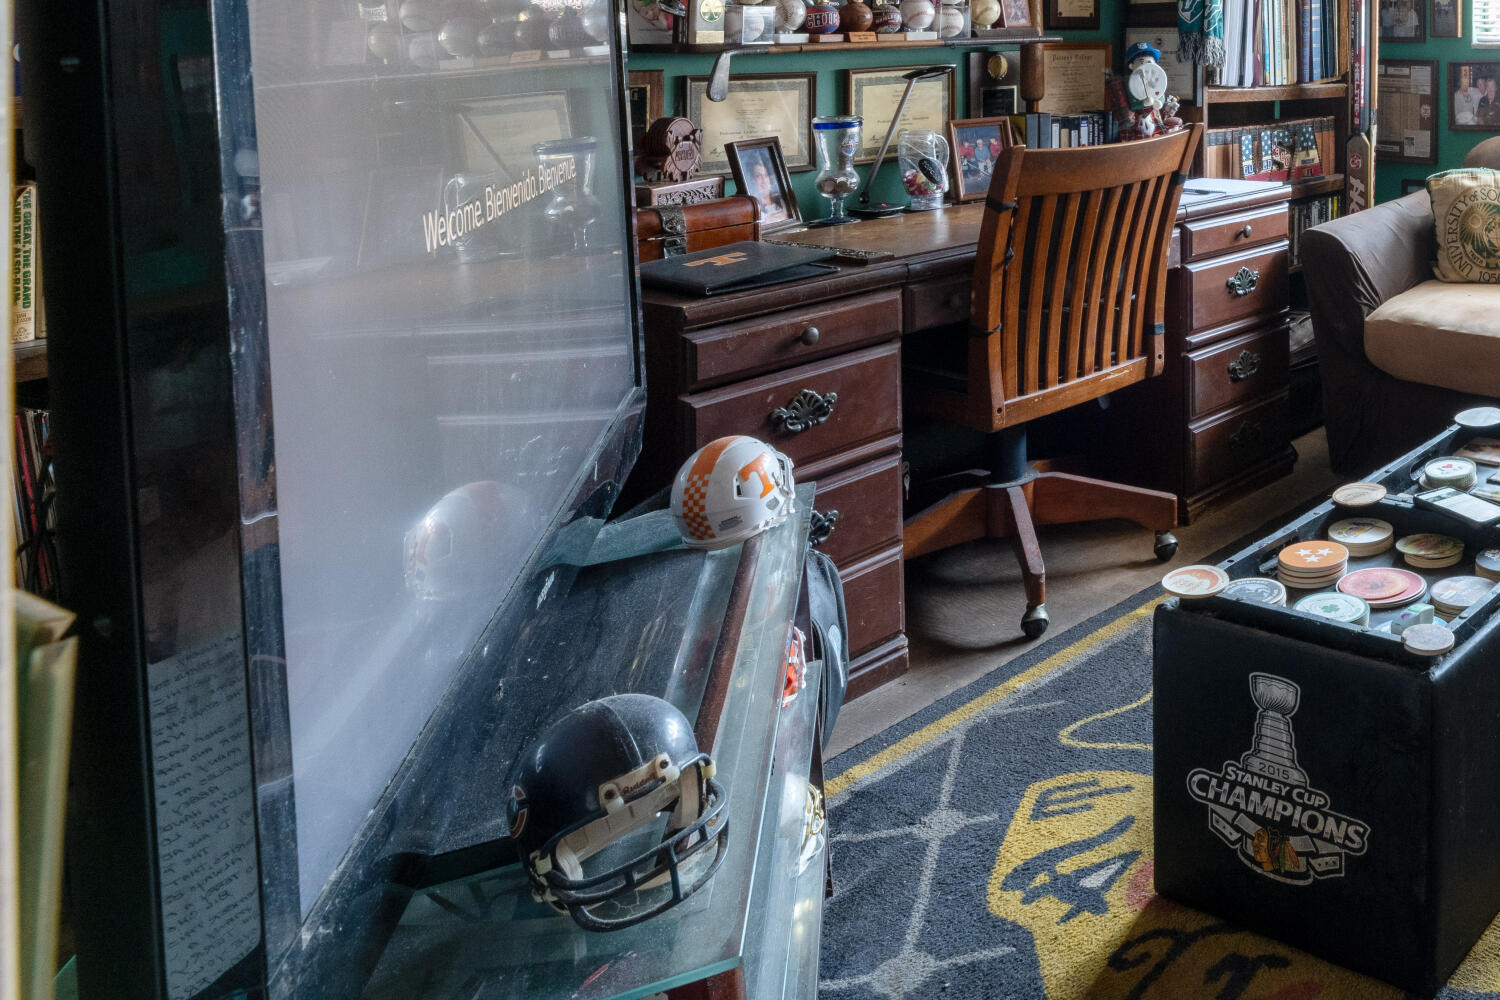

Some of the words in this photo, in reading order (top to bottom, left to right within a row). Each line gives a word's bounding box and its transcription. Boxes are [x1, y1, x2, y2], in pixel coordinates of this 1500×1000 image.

[806, 10, 840, 29] CHIC
[22, 188, 31, 209] THE
[423, 201, 485, 253] Welcome.
[485, 168, 538, 222] Bienvenido.
[538, 157, 577, 195] Bienvenue
[22, 211, 31, 247] GREAT,
[1445, 195, 1474, 281] UNIVERSITY
[22, 248, 31, 268] THE
[22, 270, 31, 309] GRAND
[1226, 766, 1290, 795] STANLEY
[1292, 787, 1327, 808] CUP
[1259, 762, 1290, 780] 2015
[1190, 773, 1365, 850] CHAMPIONS
